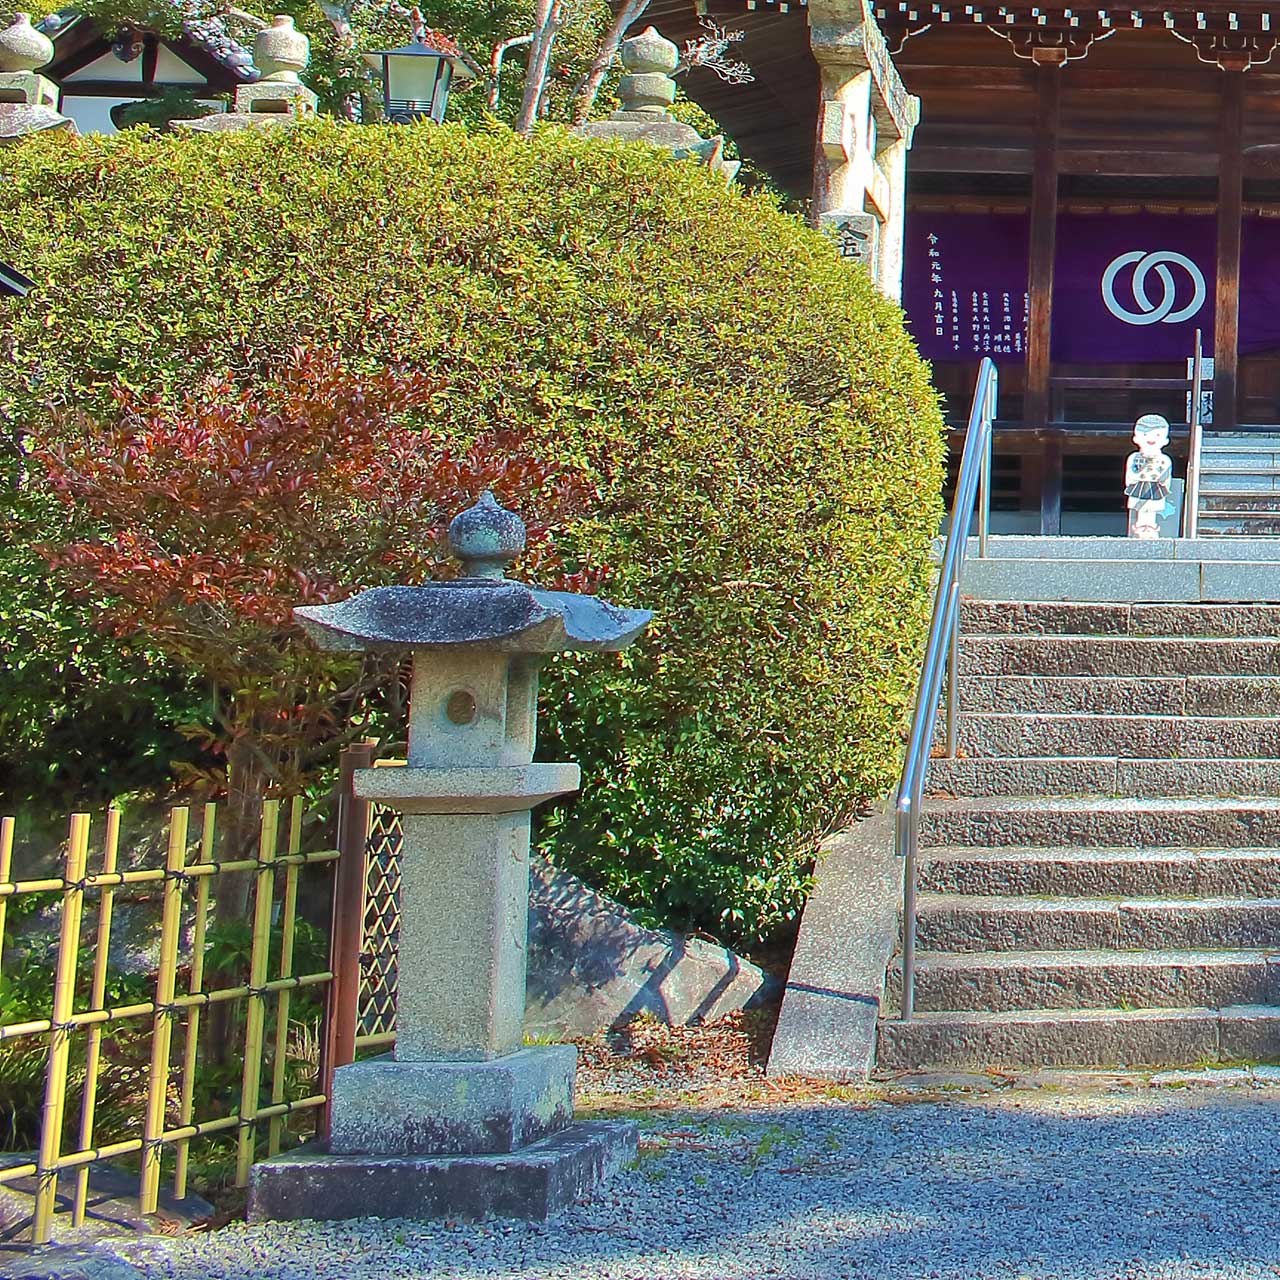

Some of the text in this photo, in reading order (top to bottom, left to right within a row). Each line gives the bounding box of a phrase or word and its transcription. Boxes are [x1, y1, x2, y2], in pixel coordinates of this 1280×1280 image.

[927, 232, 945, 336] 令和元年九月吉日
